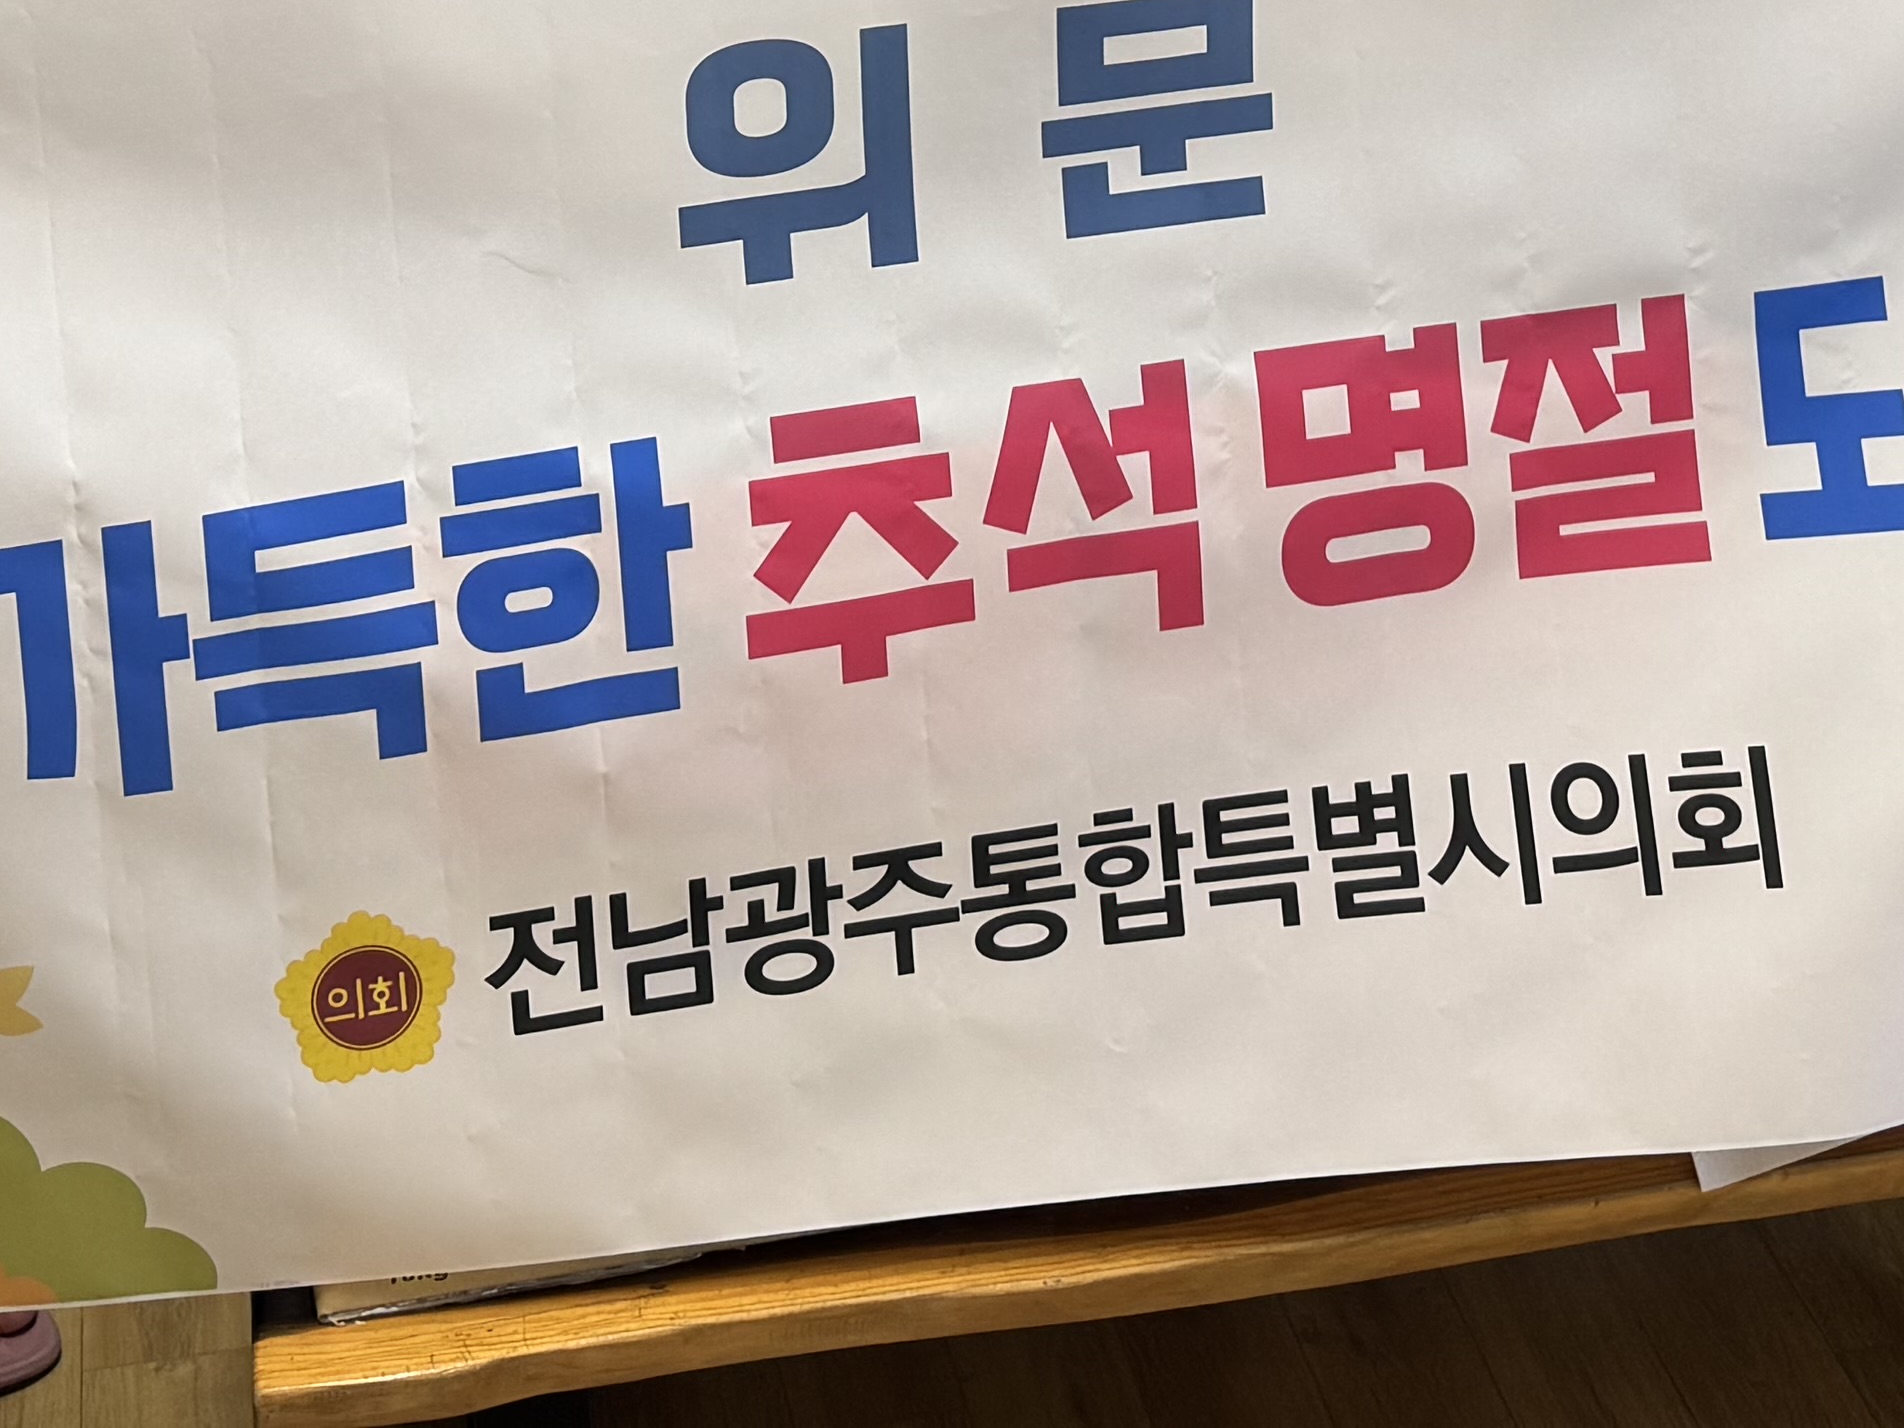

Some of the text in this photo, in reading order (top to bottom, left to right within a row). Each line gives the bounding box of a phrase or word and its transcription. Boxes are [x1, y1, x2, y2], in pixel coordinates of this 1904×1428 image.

[682, 30, 918, 283] 위
[747, 361, 1204, 683] 추석
[1255, 296, 1711, 606] 명절
[324, 970, 410, 1023] 의회
[485, 746, 1783, 1035] 전남광주통합특별시의회
